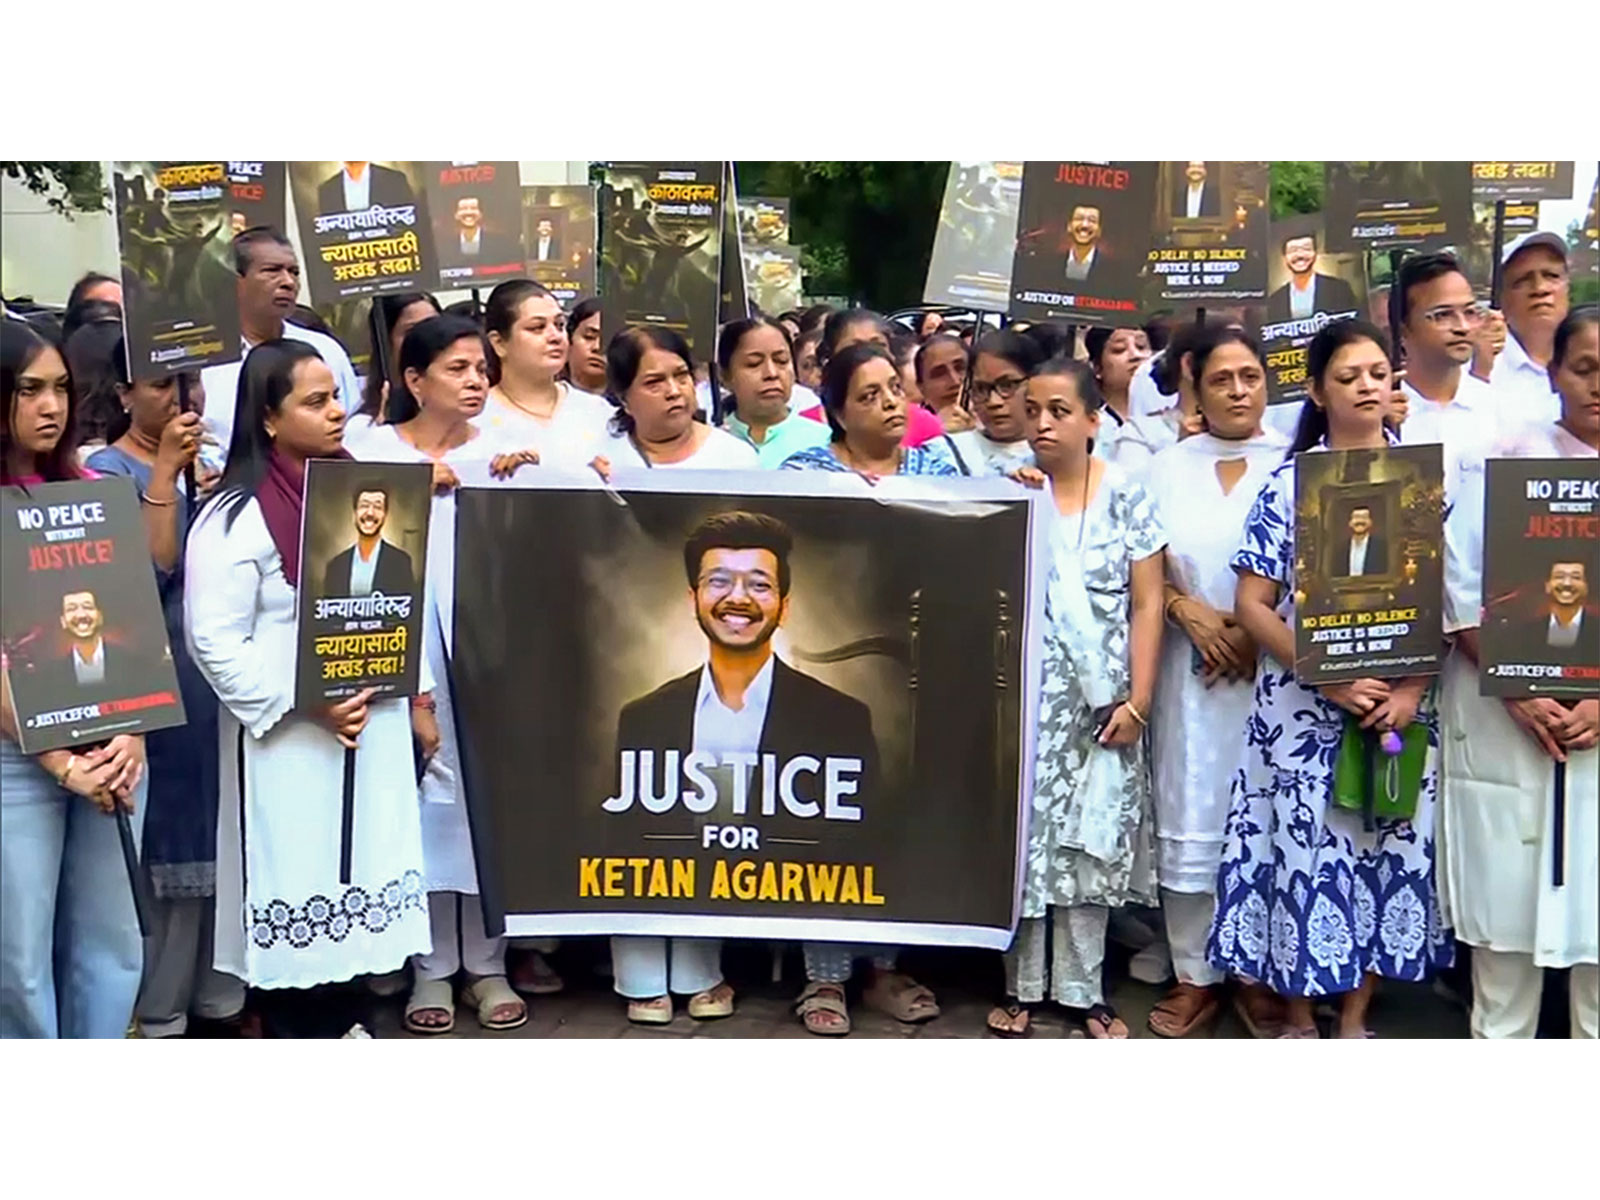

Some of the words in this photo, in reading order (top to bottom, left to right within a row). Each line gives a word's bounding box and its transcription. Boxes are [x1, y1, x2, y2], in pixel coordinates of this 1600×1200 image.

[320, 231, 418, 262] न्यायासाठी
[332, 259, 377, 281] अखंड
[1526, 480, 1552, 499] NO
[1557, 480, 1599, 499] PEAC
[17, 509, 44, 530] NO
[48, 502, 105, 527] PEACE
[314, 590, 412, 619] अन्यायाविरुद्ध
[1375, 608, 1418, 623] SILENCE
[314, 626, 408, 655] न्यायासाठी
[1310, 629, 1352, 642] JUSTICE
[321, 655, 365, 679] अखंड
[602, 750, 862, 821] JUSTICE
[702, 825, 760, 850] FOR
[579, 857, 696, 898] KETAN
[709, 860, 886, 905] AGARWAL
